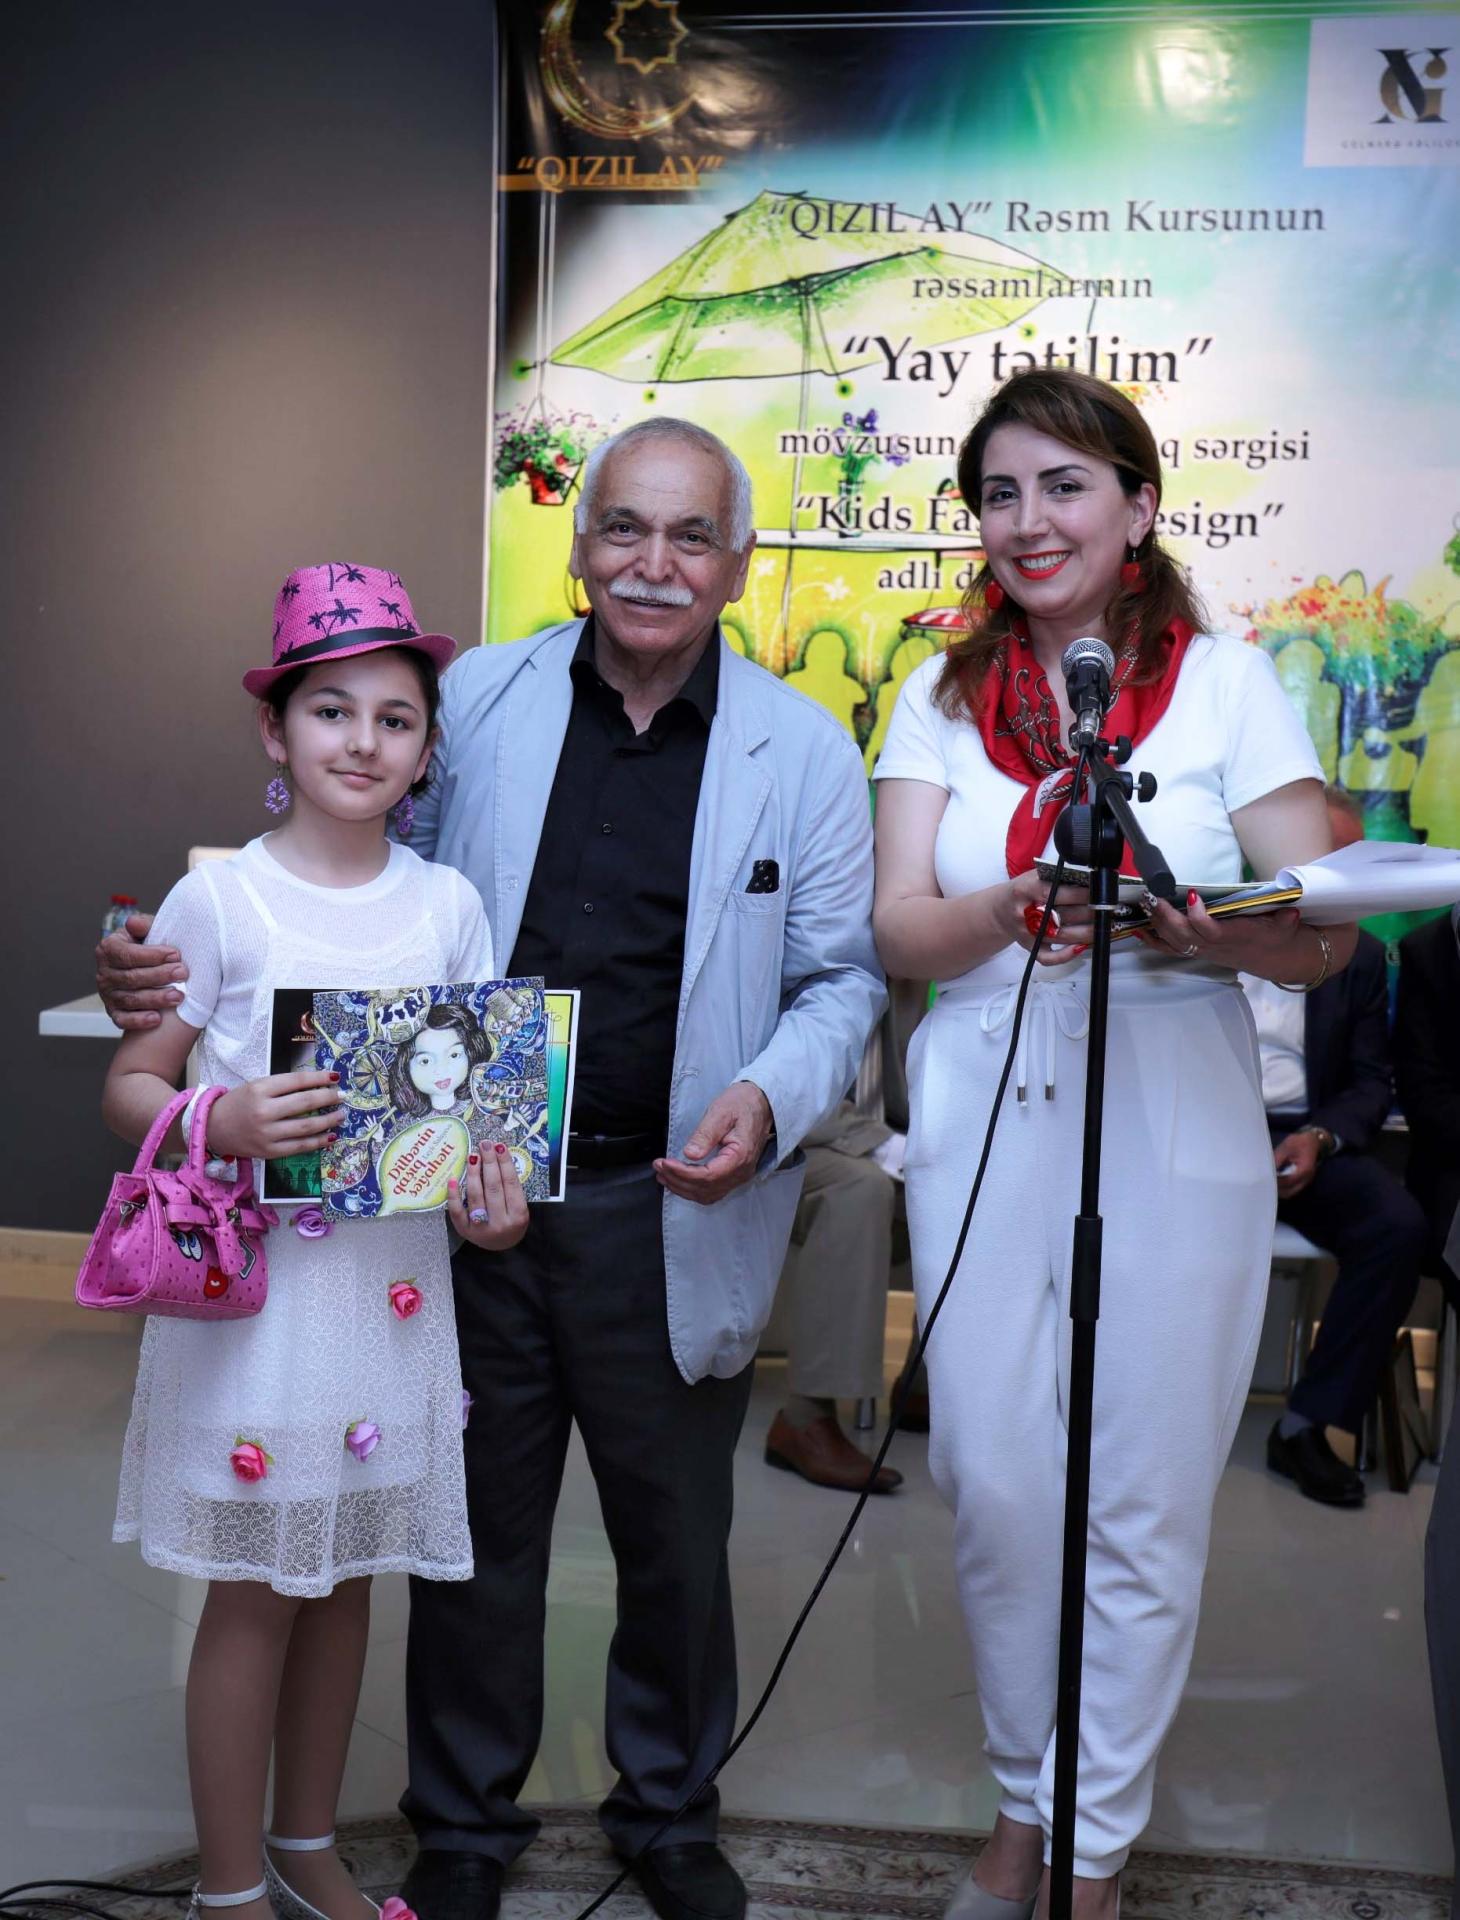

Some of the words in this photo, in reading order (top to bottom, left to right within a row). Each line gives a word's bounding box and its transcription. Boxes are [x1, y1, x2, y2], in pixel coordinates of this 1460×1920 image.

[770, 201, 907, 240] “QIZIL
[920, 200, 993, 233] AY”
[1006, 202, 1111, 233] Rəsm
[1125, 200, 1326, 232] Kursunun
[912, 269, 1153, 299] rəssamlarının
[841, 336, 971, 398] “Yay
[780, 427, 956, 456] mövzusun
[1193, 430, 1311, 470] sərgisi
[1153, 501, 1285, 549] esign”
[877, 560, 942, 590] adli
[387, 1128, 435, 1181] Dilbərin
[409, 1142, 455, 1198] səyahəti
